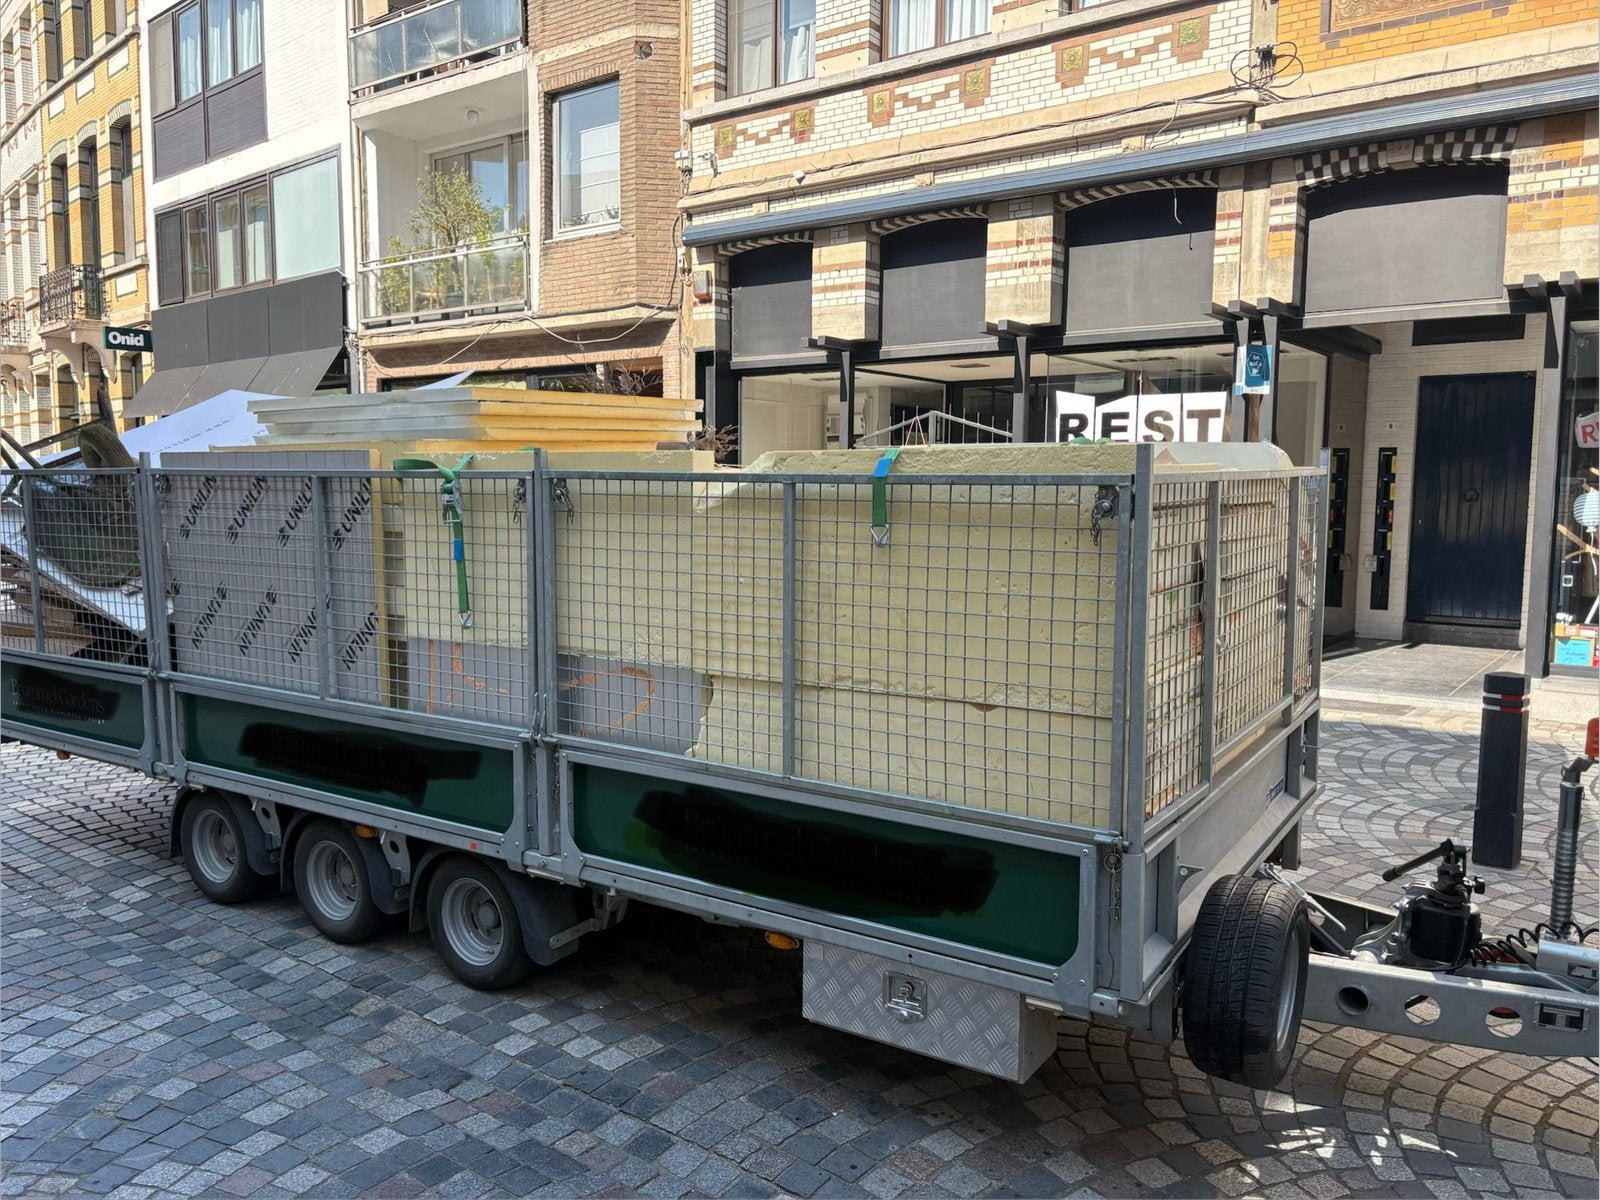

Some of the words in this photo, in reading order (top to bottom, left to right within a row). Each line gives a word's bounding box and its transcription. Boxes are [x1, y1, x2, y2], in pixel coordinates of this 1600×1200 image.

[108, 331, 144, 346] Onid
[1059, 409, 1221, 443] REST
[1581, 422, 1599, 444] R
